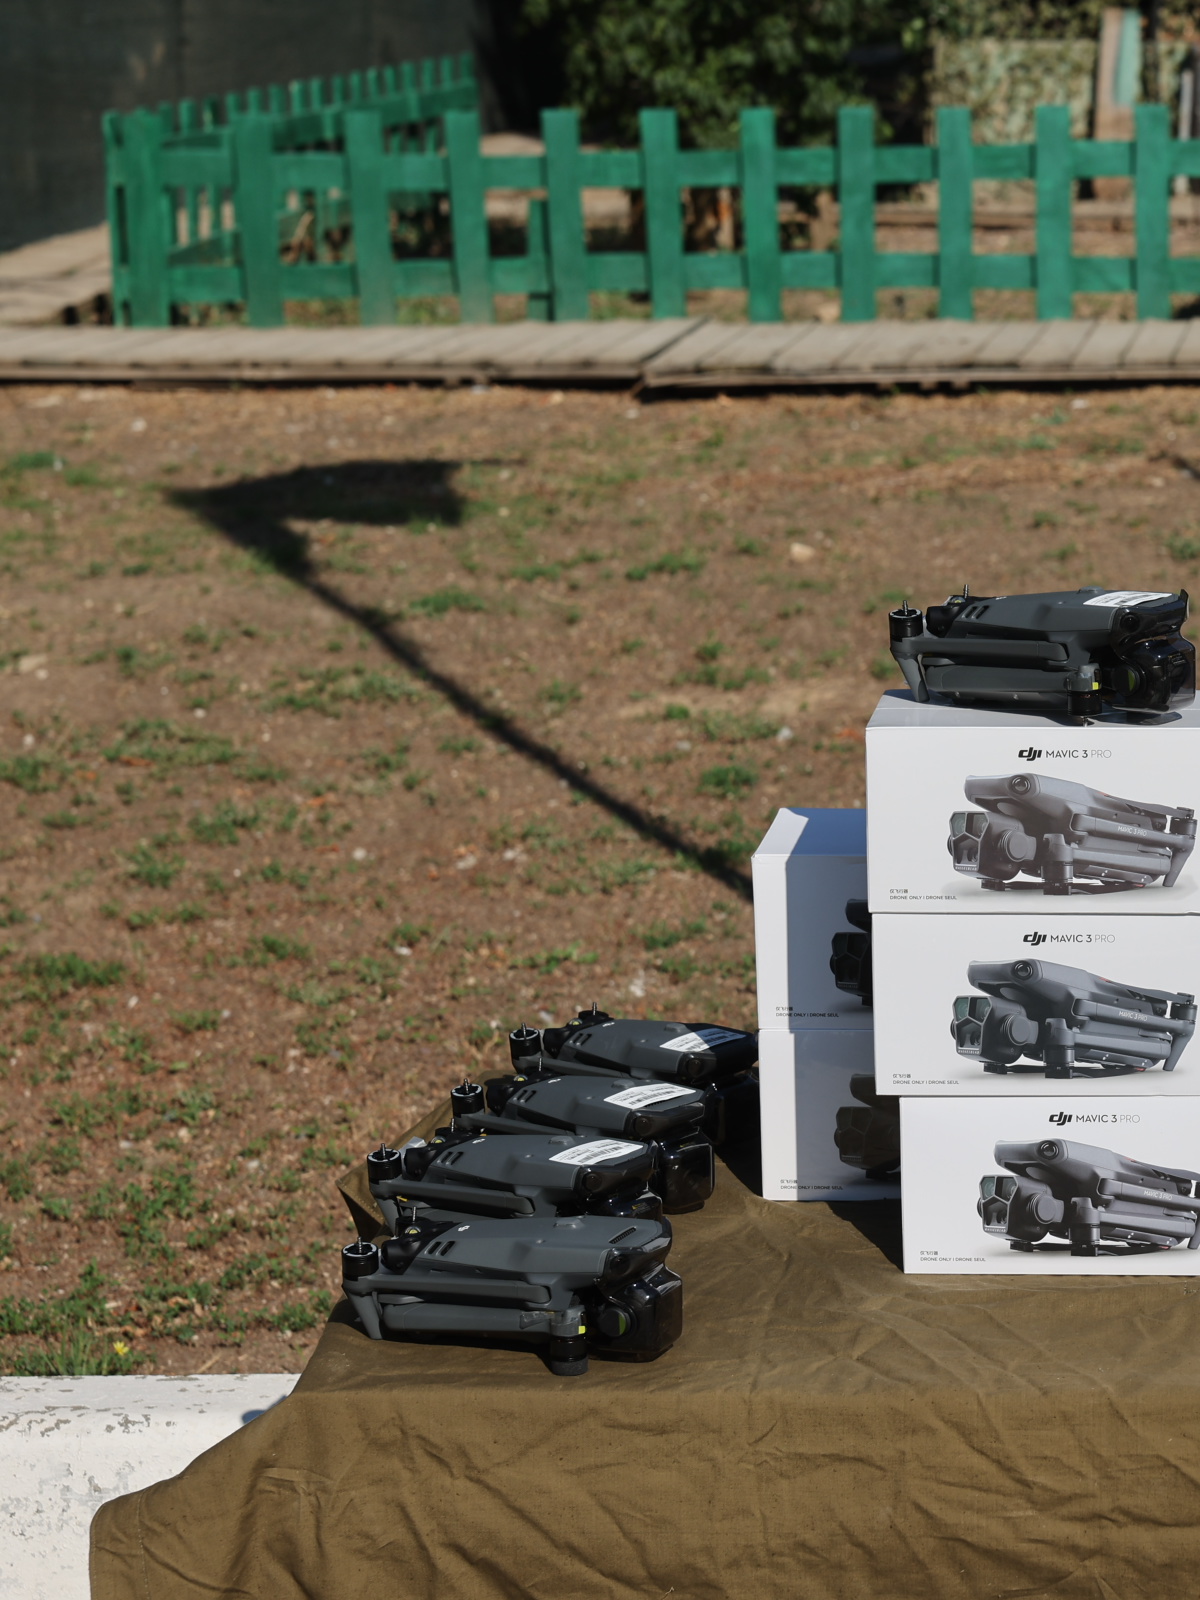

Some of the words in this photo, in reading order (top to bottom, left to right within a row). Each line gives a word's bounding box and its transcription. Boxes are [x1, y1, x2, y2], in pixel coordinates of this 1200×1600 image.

[1046, 749, 1080, 759] MAVIC
[1082, 749, 1089, 759] 3
[1091, 749, 1113, 759] PRO
[1051, 933, 1084, 944] MAVIC
[1086, 933, 1093, 944] 3
[1095, 934, 1116, 944] PRO
[1076, 1114, 1109, 1124] MAVIC
[1111, 1114, 1118, 1124] 3
[1120, 1114, 1141, 1124] PRO
